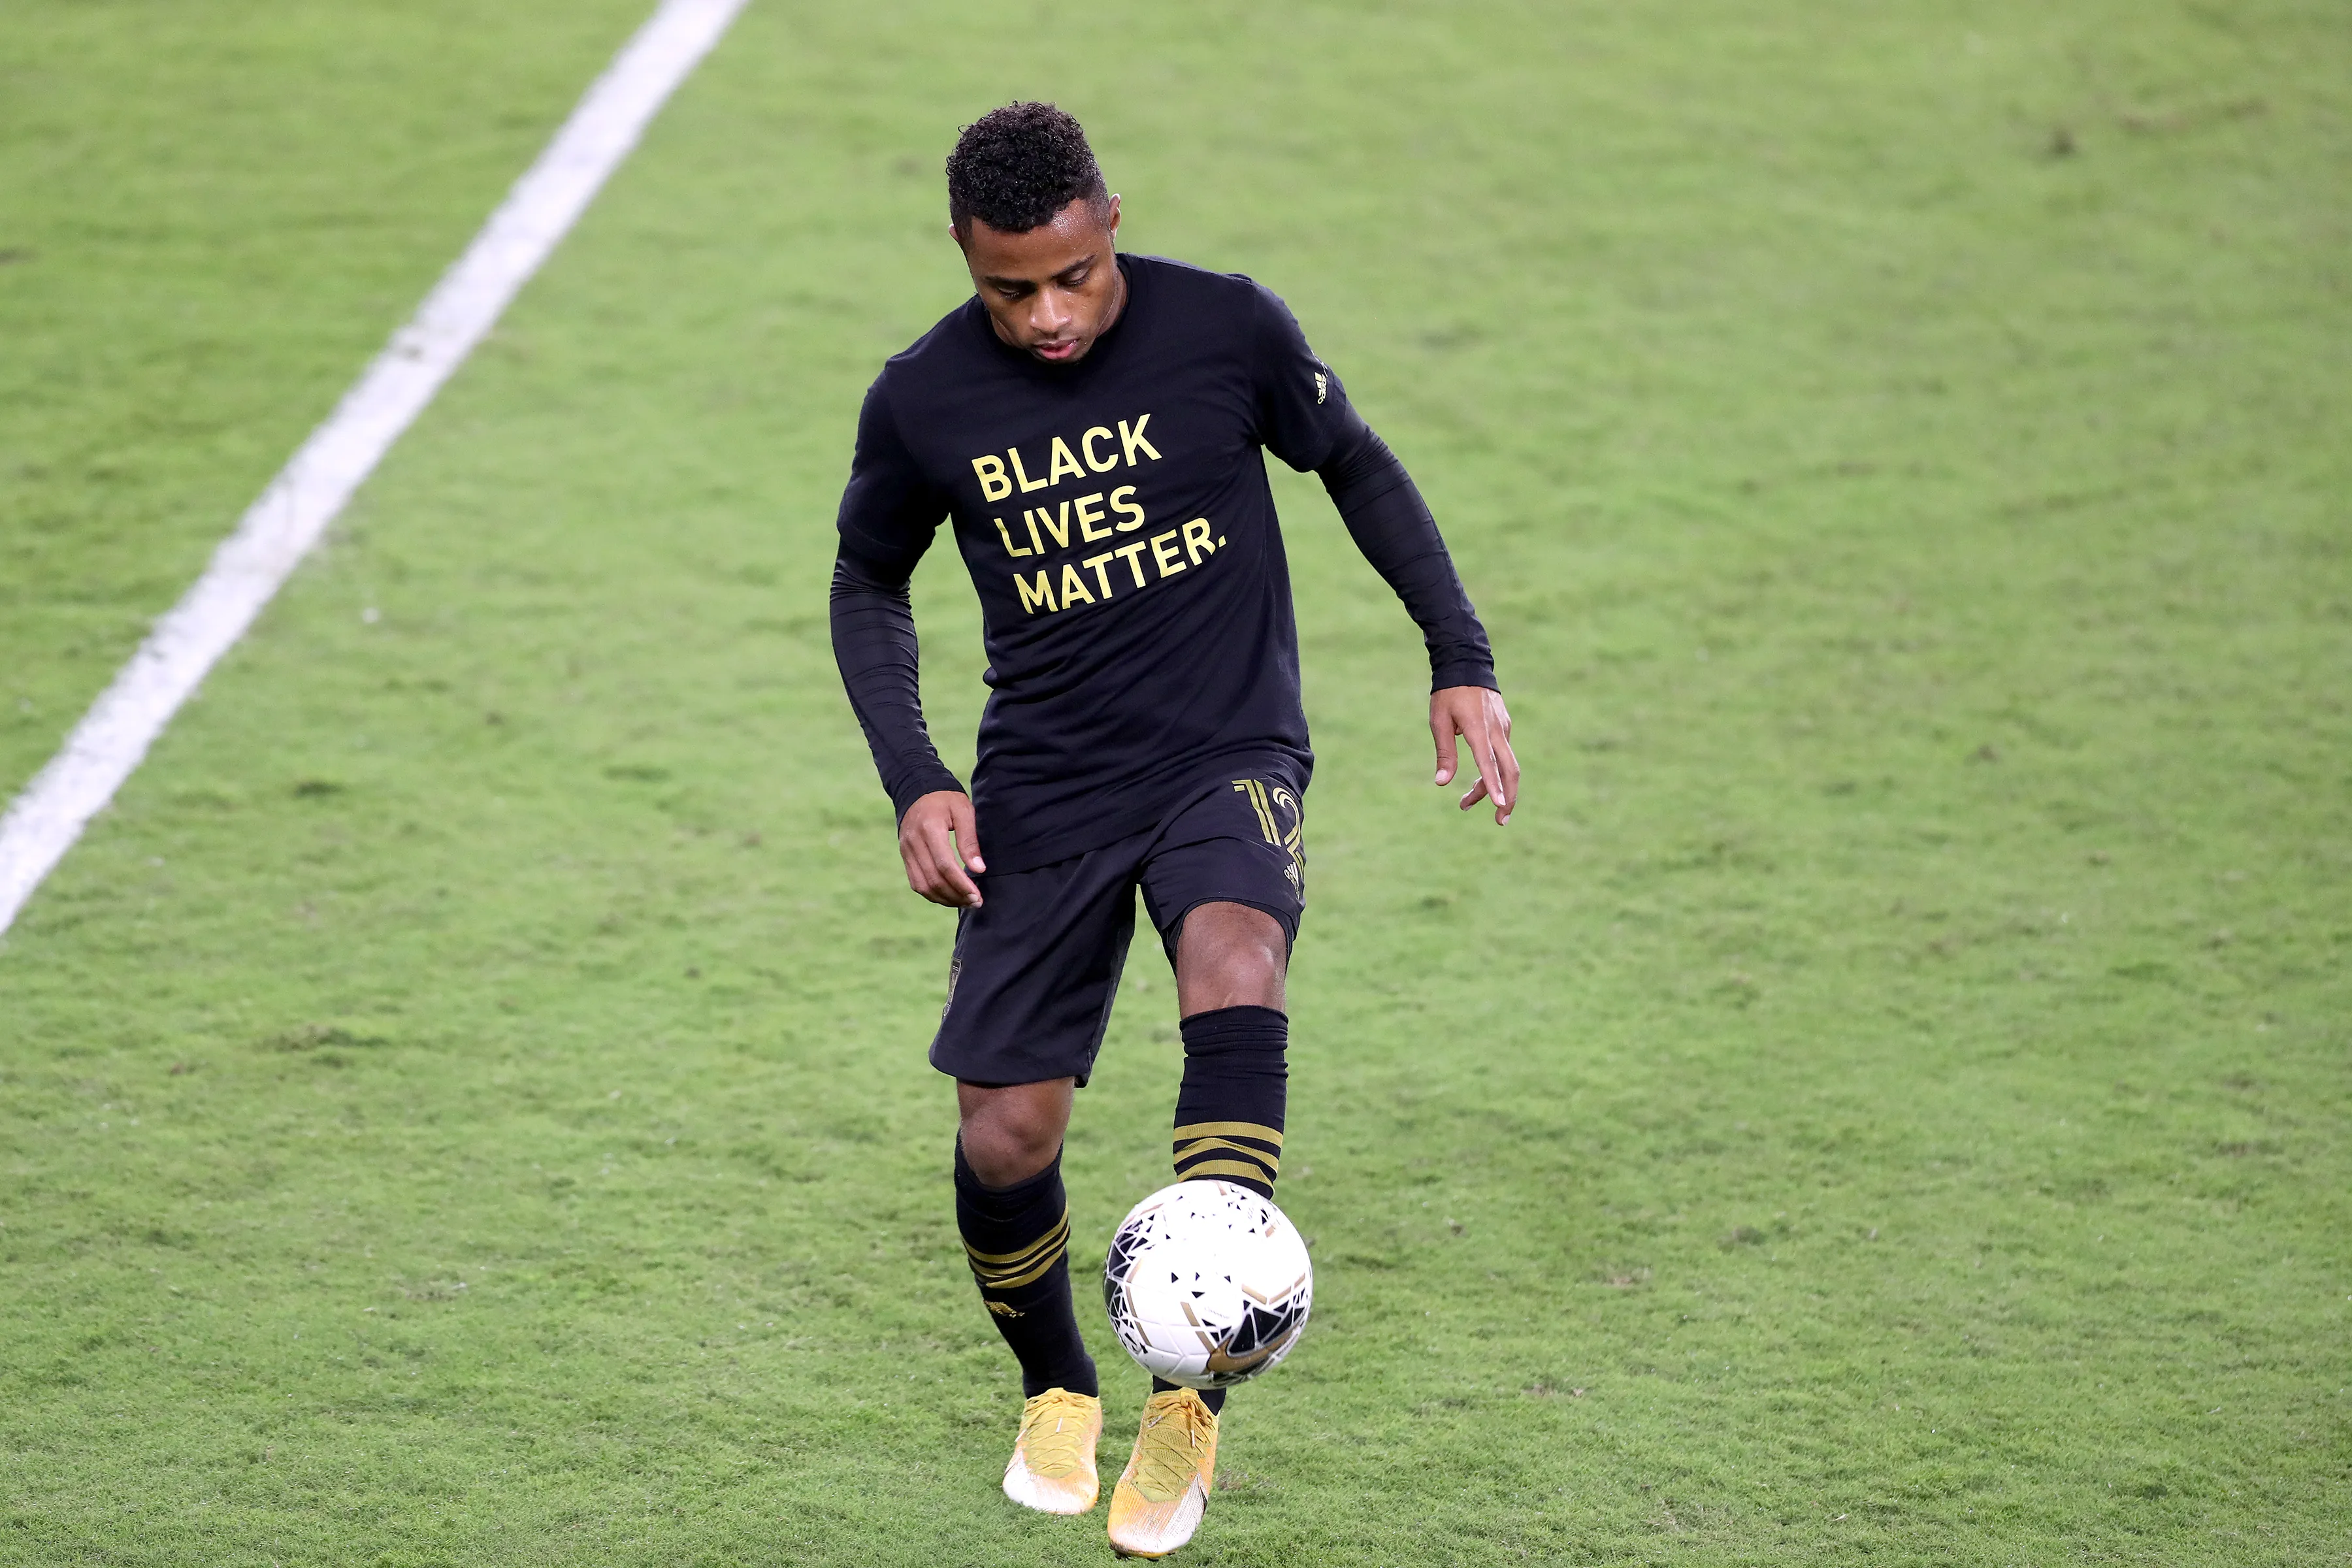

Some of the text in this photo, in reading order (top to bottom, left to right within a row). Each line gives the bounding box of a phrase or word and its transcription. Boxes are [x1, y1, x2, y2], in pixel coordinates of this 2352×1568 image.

[972, 414, 1162, 502] BLACK
[994, 485, 1145, 557] LIVES
[1013, 517, 1226, 614] MATTER.
[1231, 779, 1305, 880] 12
